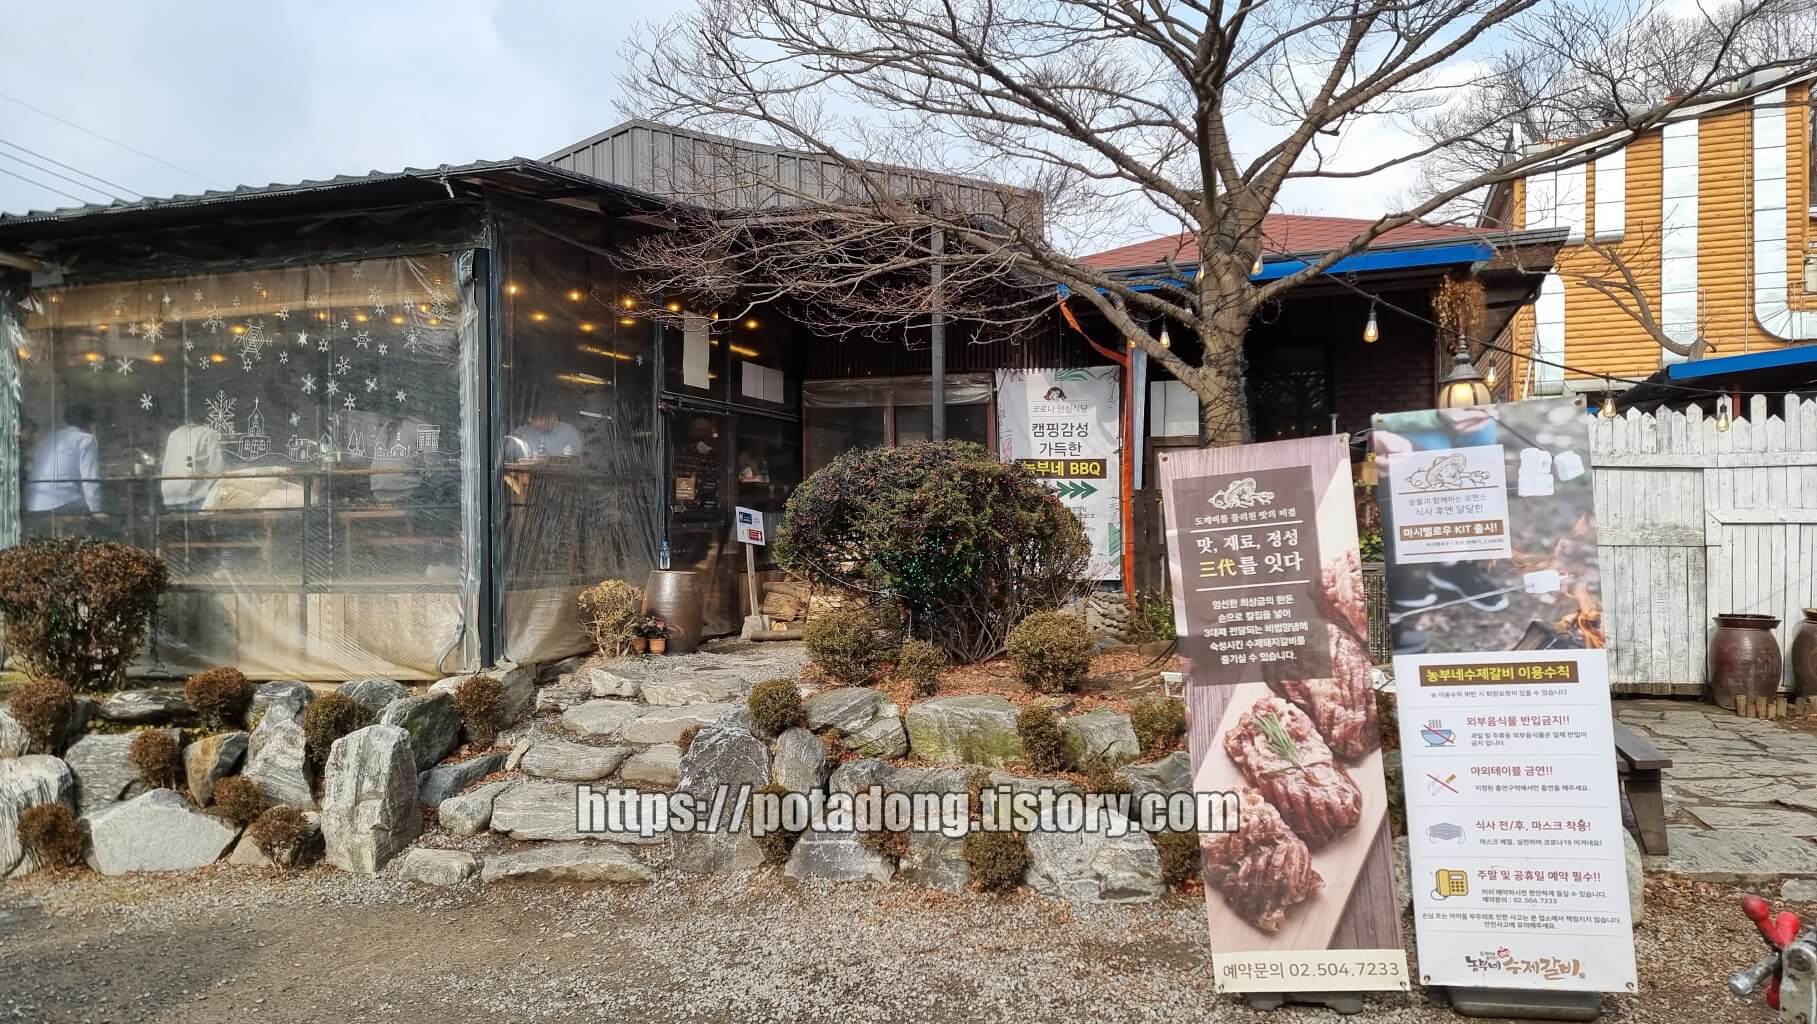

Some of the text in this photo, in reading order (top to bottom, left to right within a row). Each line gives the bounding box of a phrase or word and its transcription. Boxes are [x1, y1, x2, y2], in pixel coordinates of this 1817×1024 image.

[1031, 403, 1089, 413] 코로나 안심식당
[1031, 422, 1089, 438] 캠핑감성
[1039, 441, 1083, 457] 가득한
[1070, 461, 1101, 476] BBQ
[1259, 509, 1276, 520] 맛의
[1415, 503, 1483, 517] 식사 후엔 달달한
[1403, 522, 1498, 538] 마시멜로우 KIT 출시!
[1196, 528, 1298, 555] 맛, 재료, 정성
[1199, 551, 1304, 578] 三代를 잇다
[1212, 594, 1294, 610] 엄선한 최상급의 한돈
[1218, 608, 1291, 623] 손으로 칼집을 넣어
[1203, 621, 1309, 637] 3대째 전달되는 비법양념에
[1209, 635, 1306, 651] 숙성시킨 수제돼지갈비를
[1220, 650, 1298, 664] 즐기실 수 있습니다.
[1426, 664, 1570, 683] 농부네수제갈비 이용수칙
[1466, 715, 1570, 727] 외부음식물 반입금지!!
[1470, 766, 1553, 777] 야외테이블 금연!!
[1475, 819, 1592, 832] 식사 전/후, 마스크 착용!
[1477, 871, 1601, 882] 주말 및 공휴일 예약 필수!!
[1223, 962, 1400, 979] 예약문의 02.504.7233
[1464, 955, 1580, 980] 농부네 수제갈비
